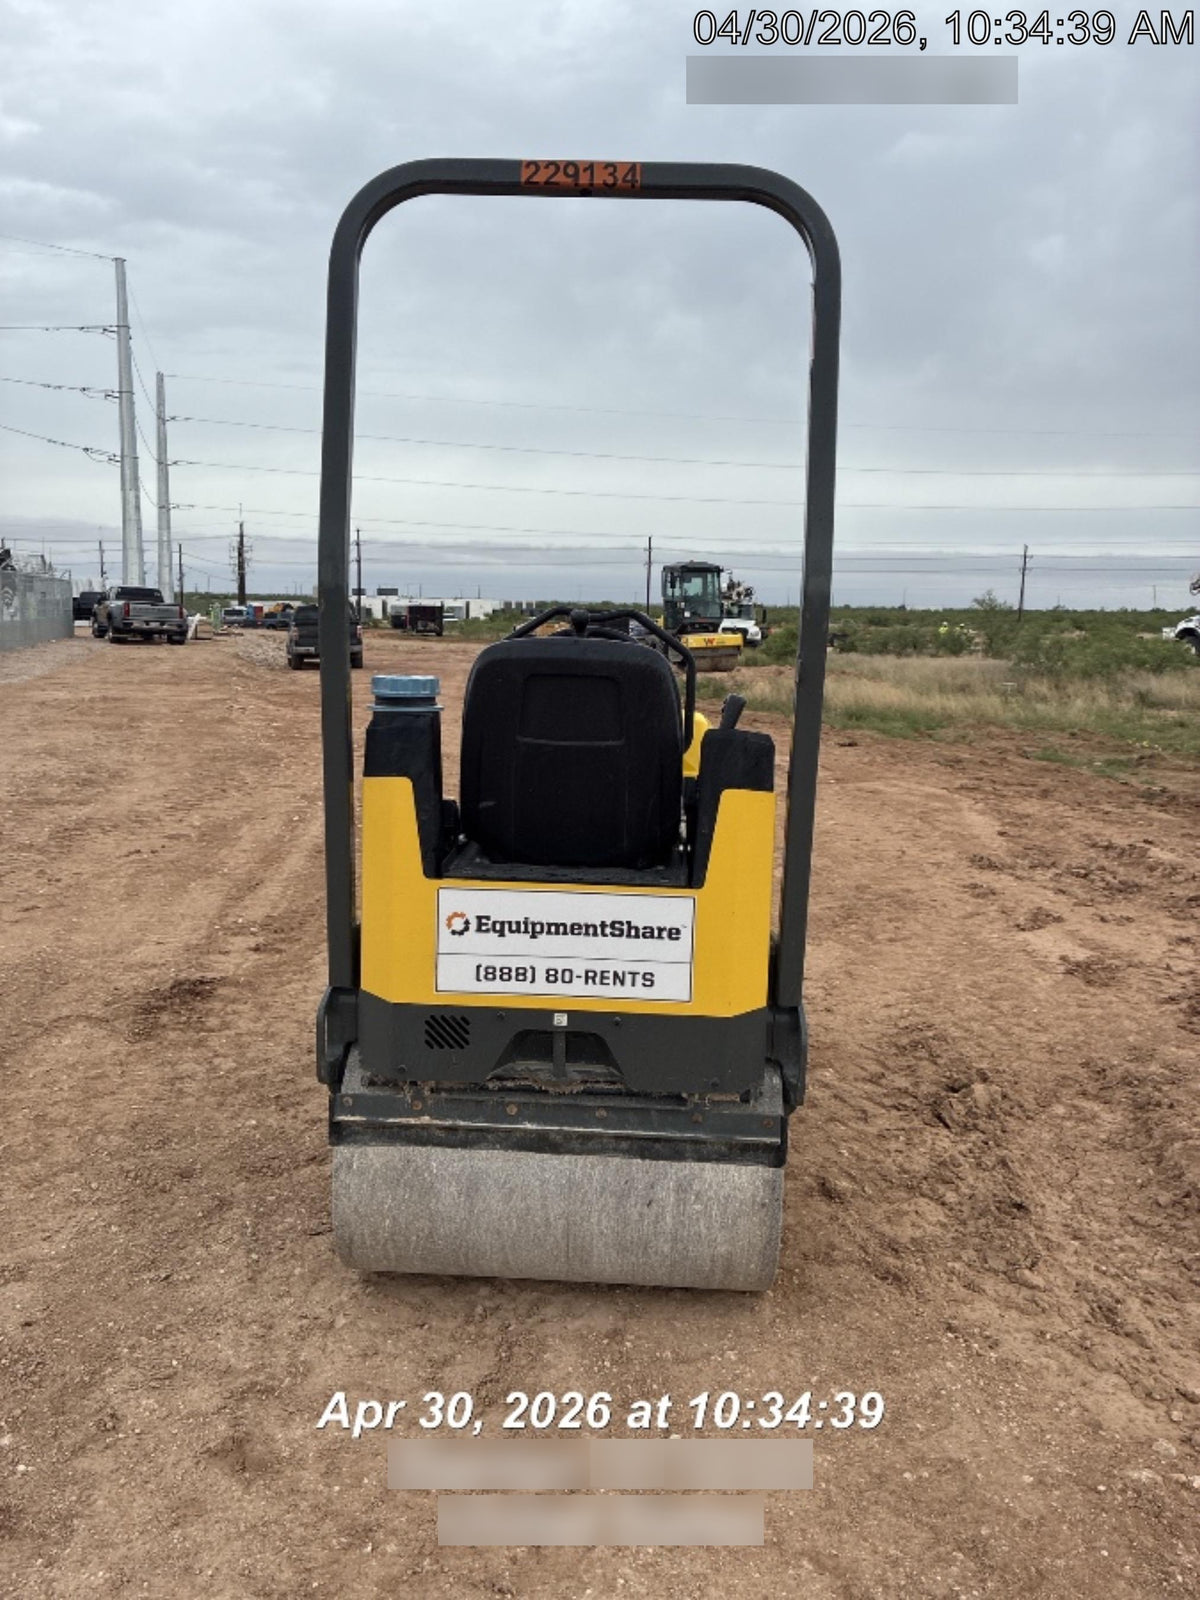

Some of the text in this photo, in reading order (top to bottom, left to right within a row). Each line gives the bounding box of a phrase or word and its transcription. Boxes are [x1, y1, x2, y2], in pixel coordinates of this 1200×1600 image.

[523, 160, 639, 189] 229134
[475, 914, 682, 941] EquipmentShare
[545, 968, 655, 988] 80-RENTS
